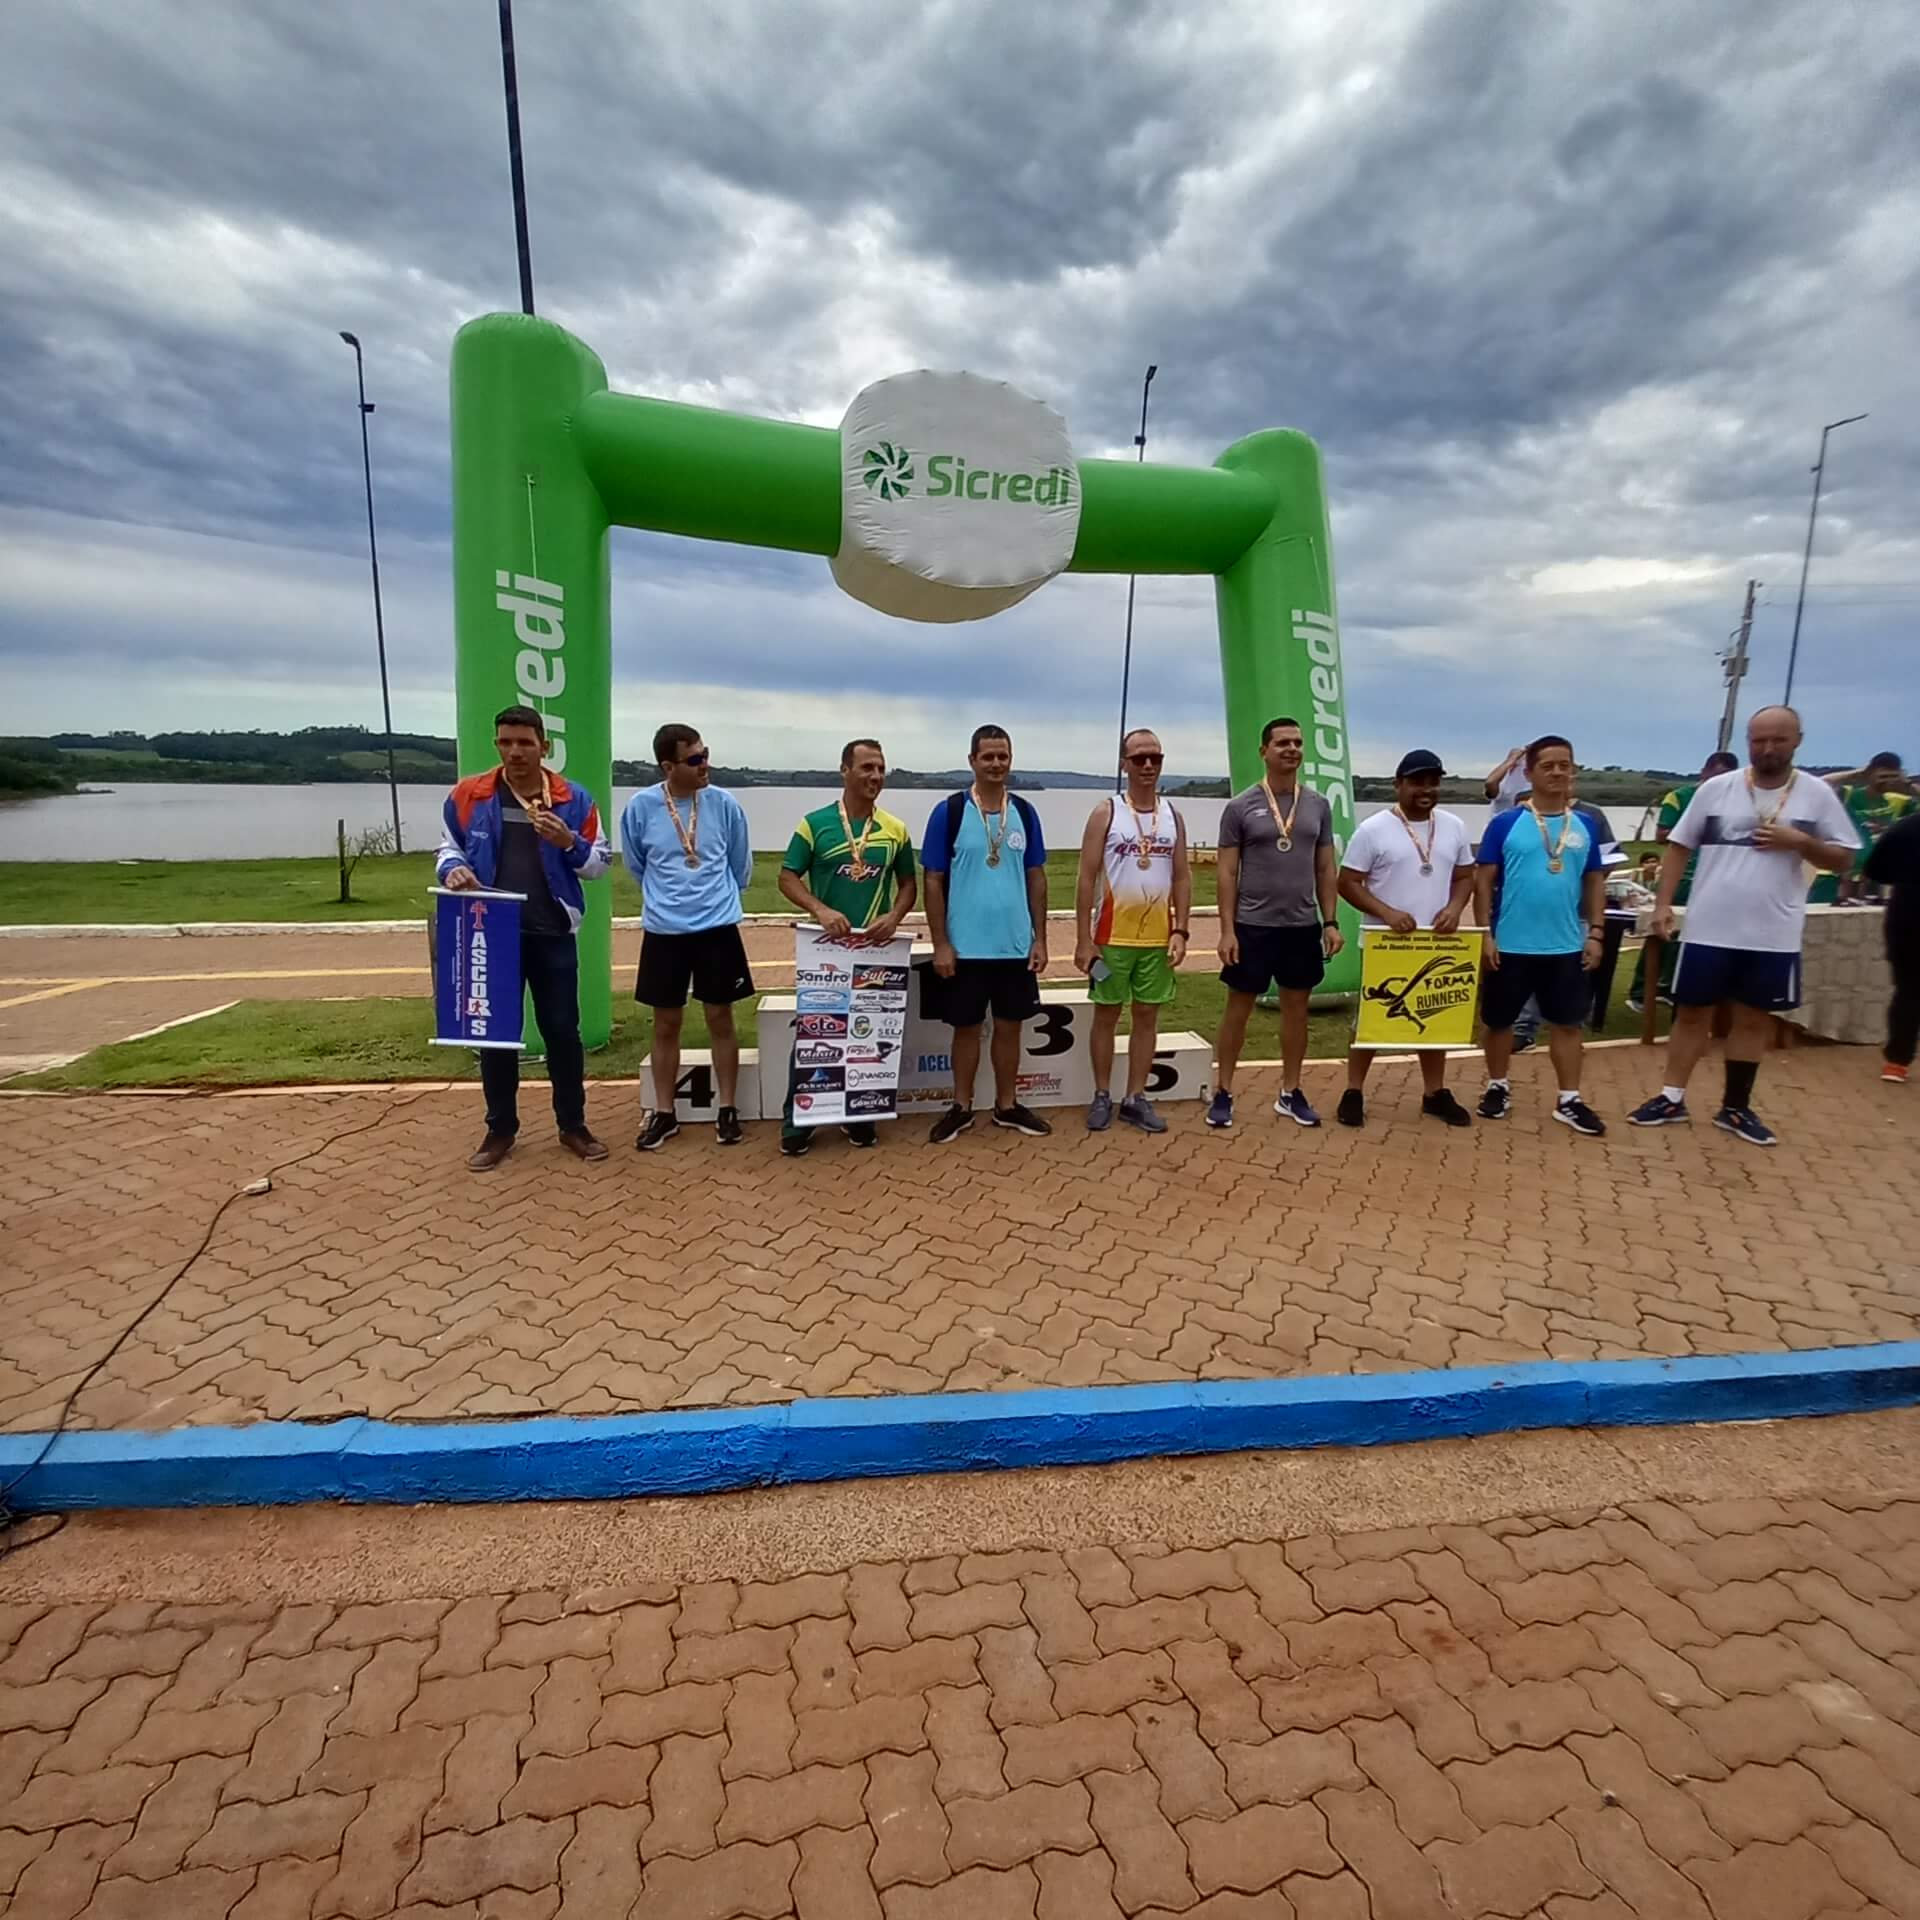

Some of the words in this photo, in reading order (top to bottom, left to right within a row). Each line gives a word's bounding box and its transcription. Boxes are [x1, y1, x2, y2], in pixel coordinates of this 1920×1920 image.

[927, 455, 1070, 506] Sicredi
[466, 931, 492, 1036] ASCORS
[797, 970, 849, 983] Sandro
[860, 969, 906, 982] SulCar
[1424, 974, 1475, 990] FORMA
[1416, 989, 1470, 1010] RUNNERS
[1024, 1004, 1075, 1056] 3
[673, 1065, 716, 1107] 4
